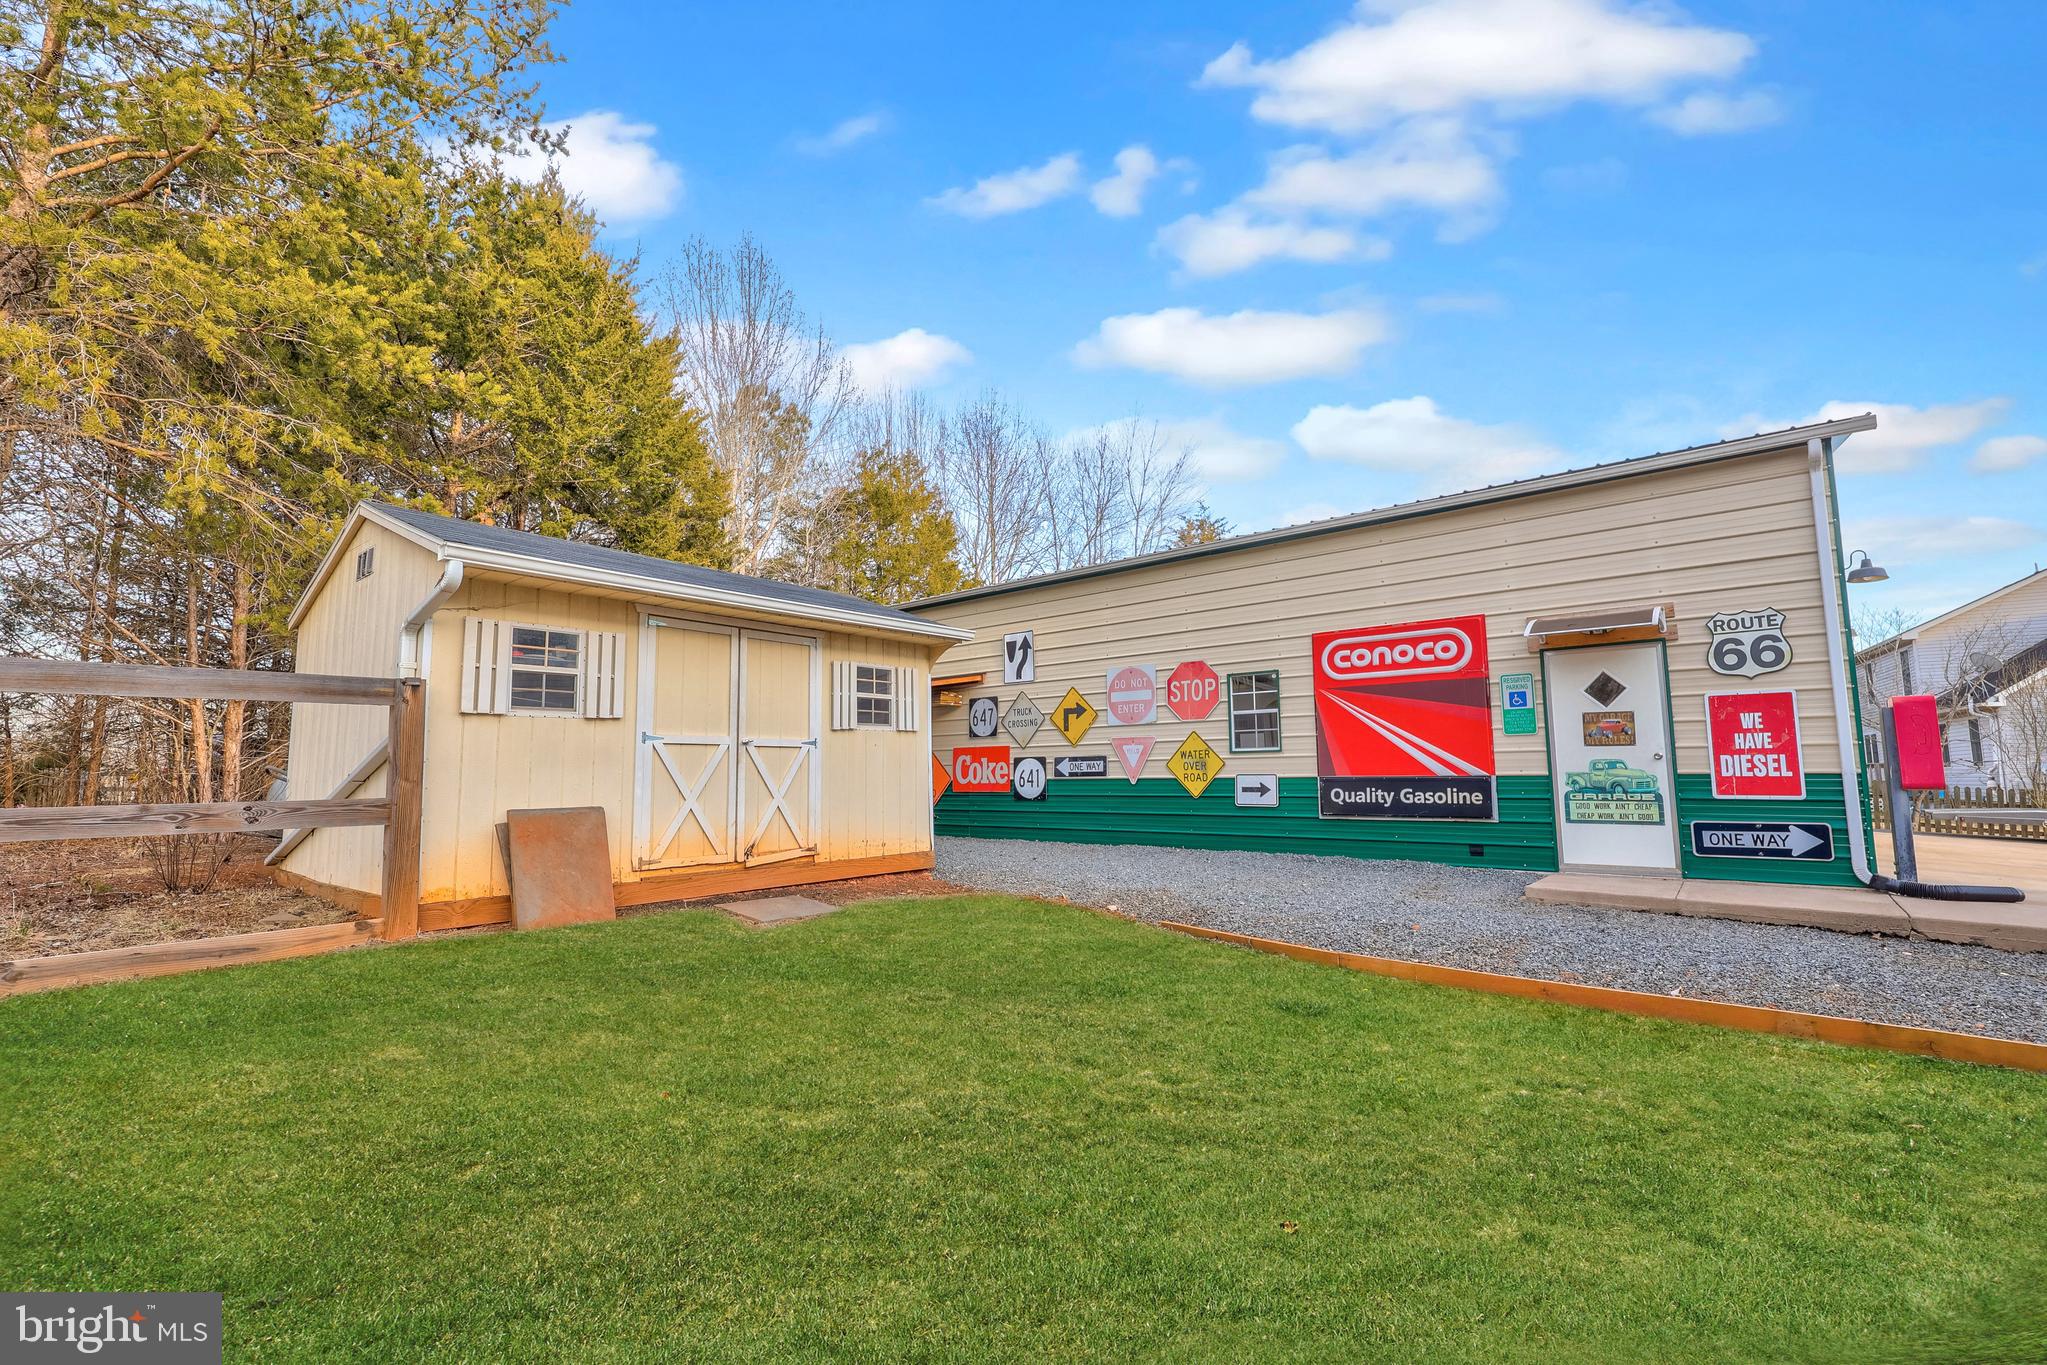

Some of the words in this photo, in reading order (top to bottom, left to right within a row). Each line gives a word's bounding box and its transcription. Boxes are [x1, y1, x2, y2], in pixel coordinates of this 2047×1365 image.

[1712, 613, 1779, 632] ROUTE
[1713, 634, 1786, 672] 66
[1114, 680, 1126, 689] DO
[1130, 677, 1148, 688] NOT
[1170, 678, 1216, 703] STOP
[1013, 708, 1033, 716] TRUCK
[1118, 703, 1145, 714] ENTER
[972, 708, 994, 727] 647
[1007, 719, 1038, 729] CROSSING
[1740, 712, 1763, 729] WE
[1734, 732, 1773, 749] HAVE
[1180, 749, 1210, 760] WATER
[955, 754, 1009, 785] Coke
[1069, 762, 1084, 771] ONE
[1085, 761, 1102, 770] WAY
[1183, 760, 1207, 771] OVER
[1720, 753, 1793, 777] DIESEL
[1018, 768, 1040, 788] 641
[1183, 772, 1208, 782] ROAD
[1330, 787, 1395, 807] Quality
[1400, 788, 1483, 806] Gasoline
[1575, 802, 1591, 810] GOOD
[1593, 802, 1611, 810] WORK
[1634, 803, 1653, 811] CHEAP
[1576, 812, 1595, 820] CHEAP
[1597, 812, 1615, 820] WORK
[1637, 813, 1654, 821] GOOD
[1709, 833, 1746, 847] ONE
[1751, 833, 1790, 847] WAY
